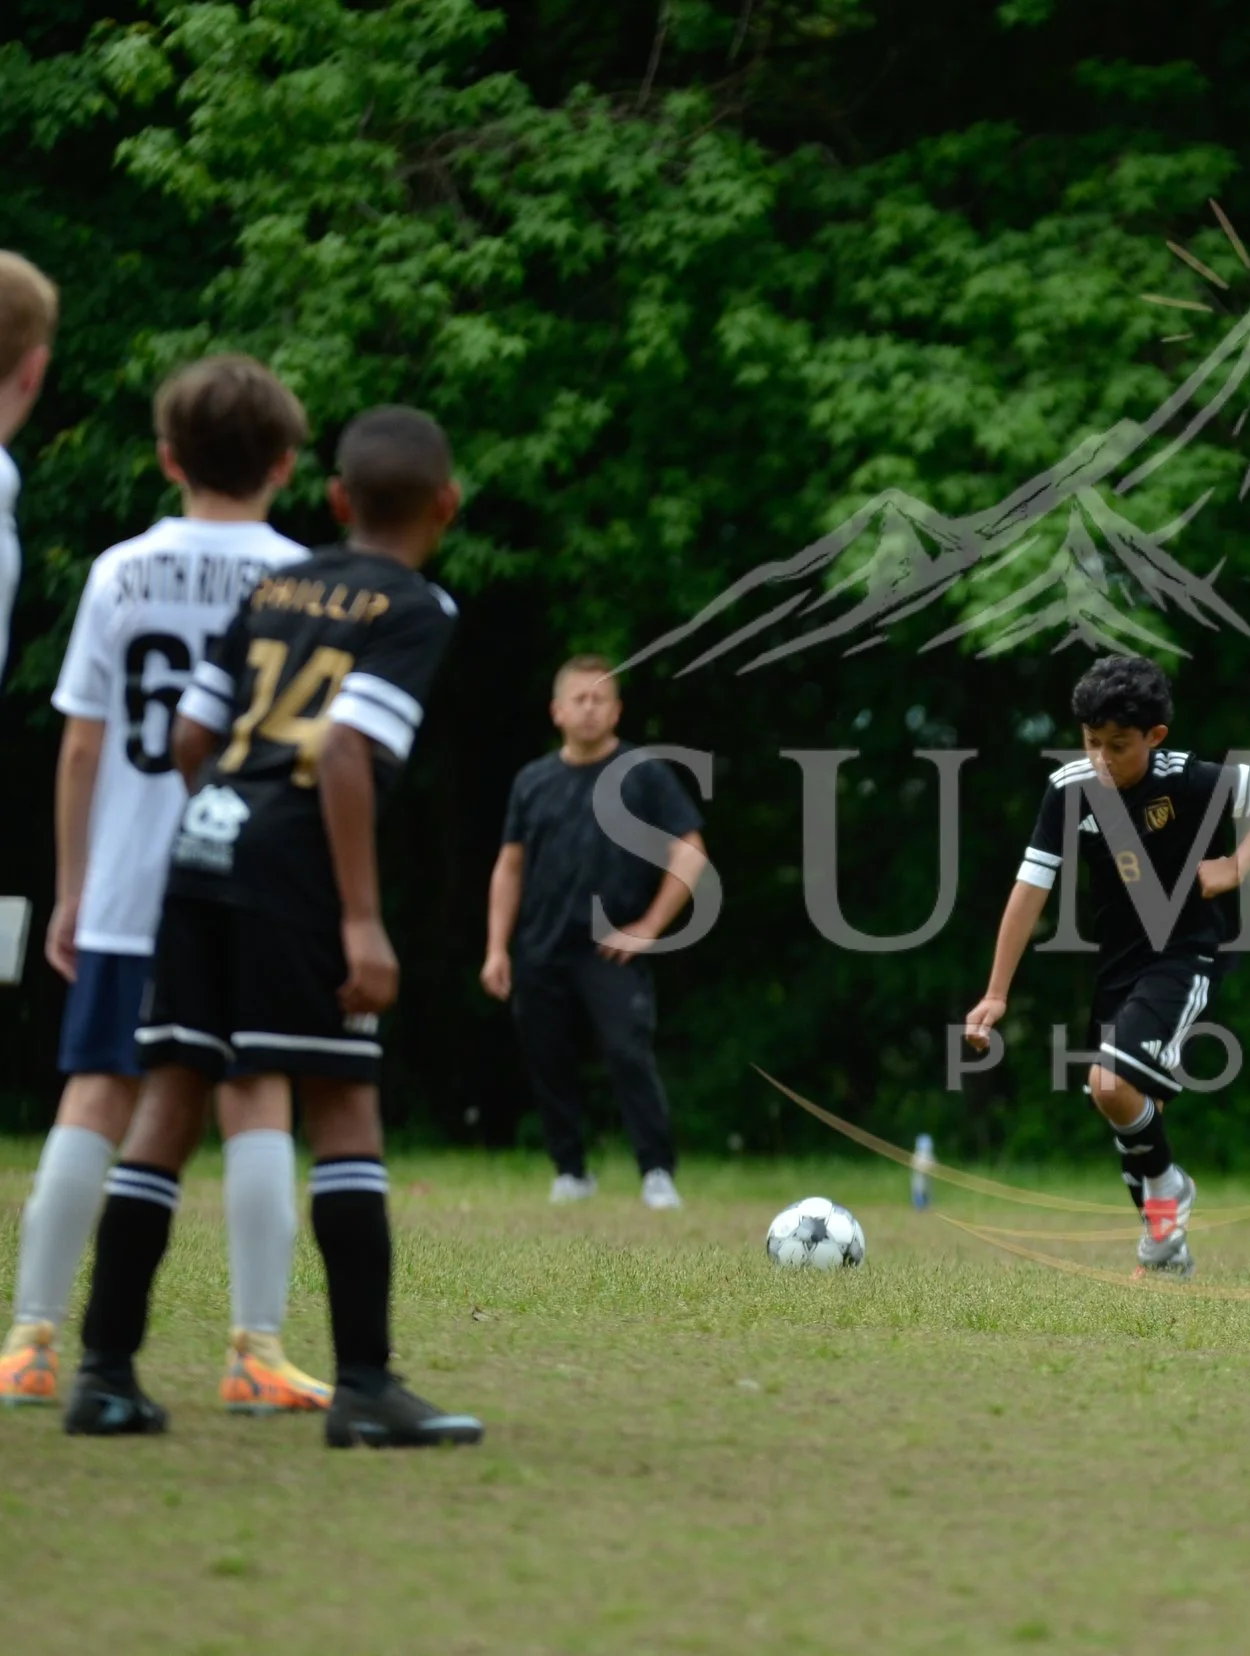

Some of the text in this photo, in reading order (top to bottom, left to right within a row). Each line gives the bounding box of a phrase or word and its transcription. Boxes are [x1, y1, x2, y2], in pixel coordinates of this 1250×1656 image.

[117, 553, 191, 605] SOUTH
[125, 632, 226, 774] 6
[217, 638, 355, 789] 14
[1114, 850, 1141, 884] 8
